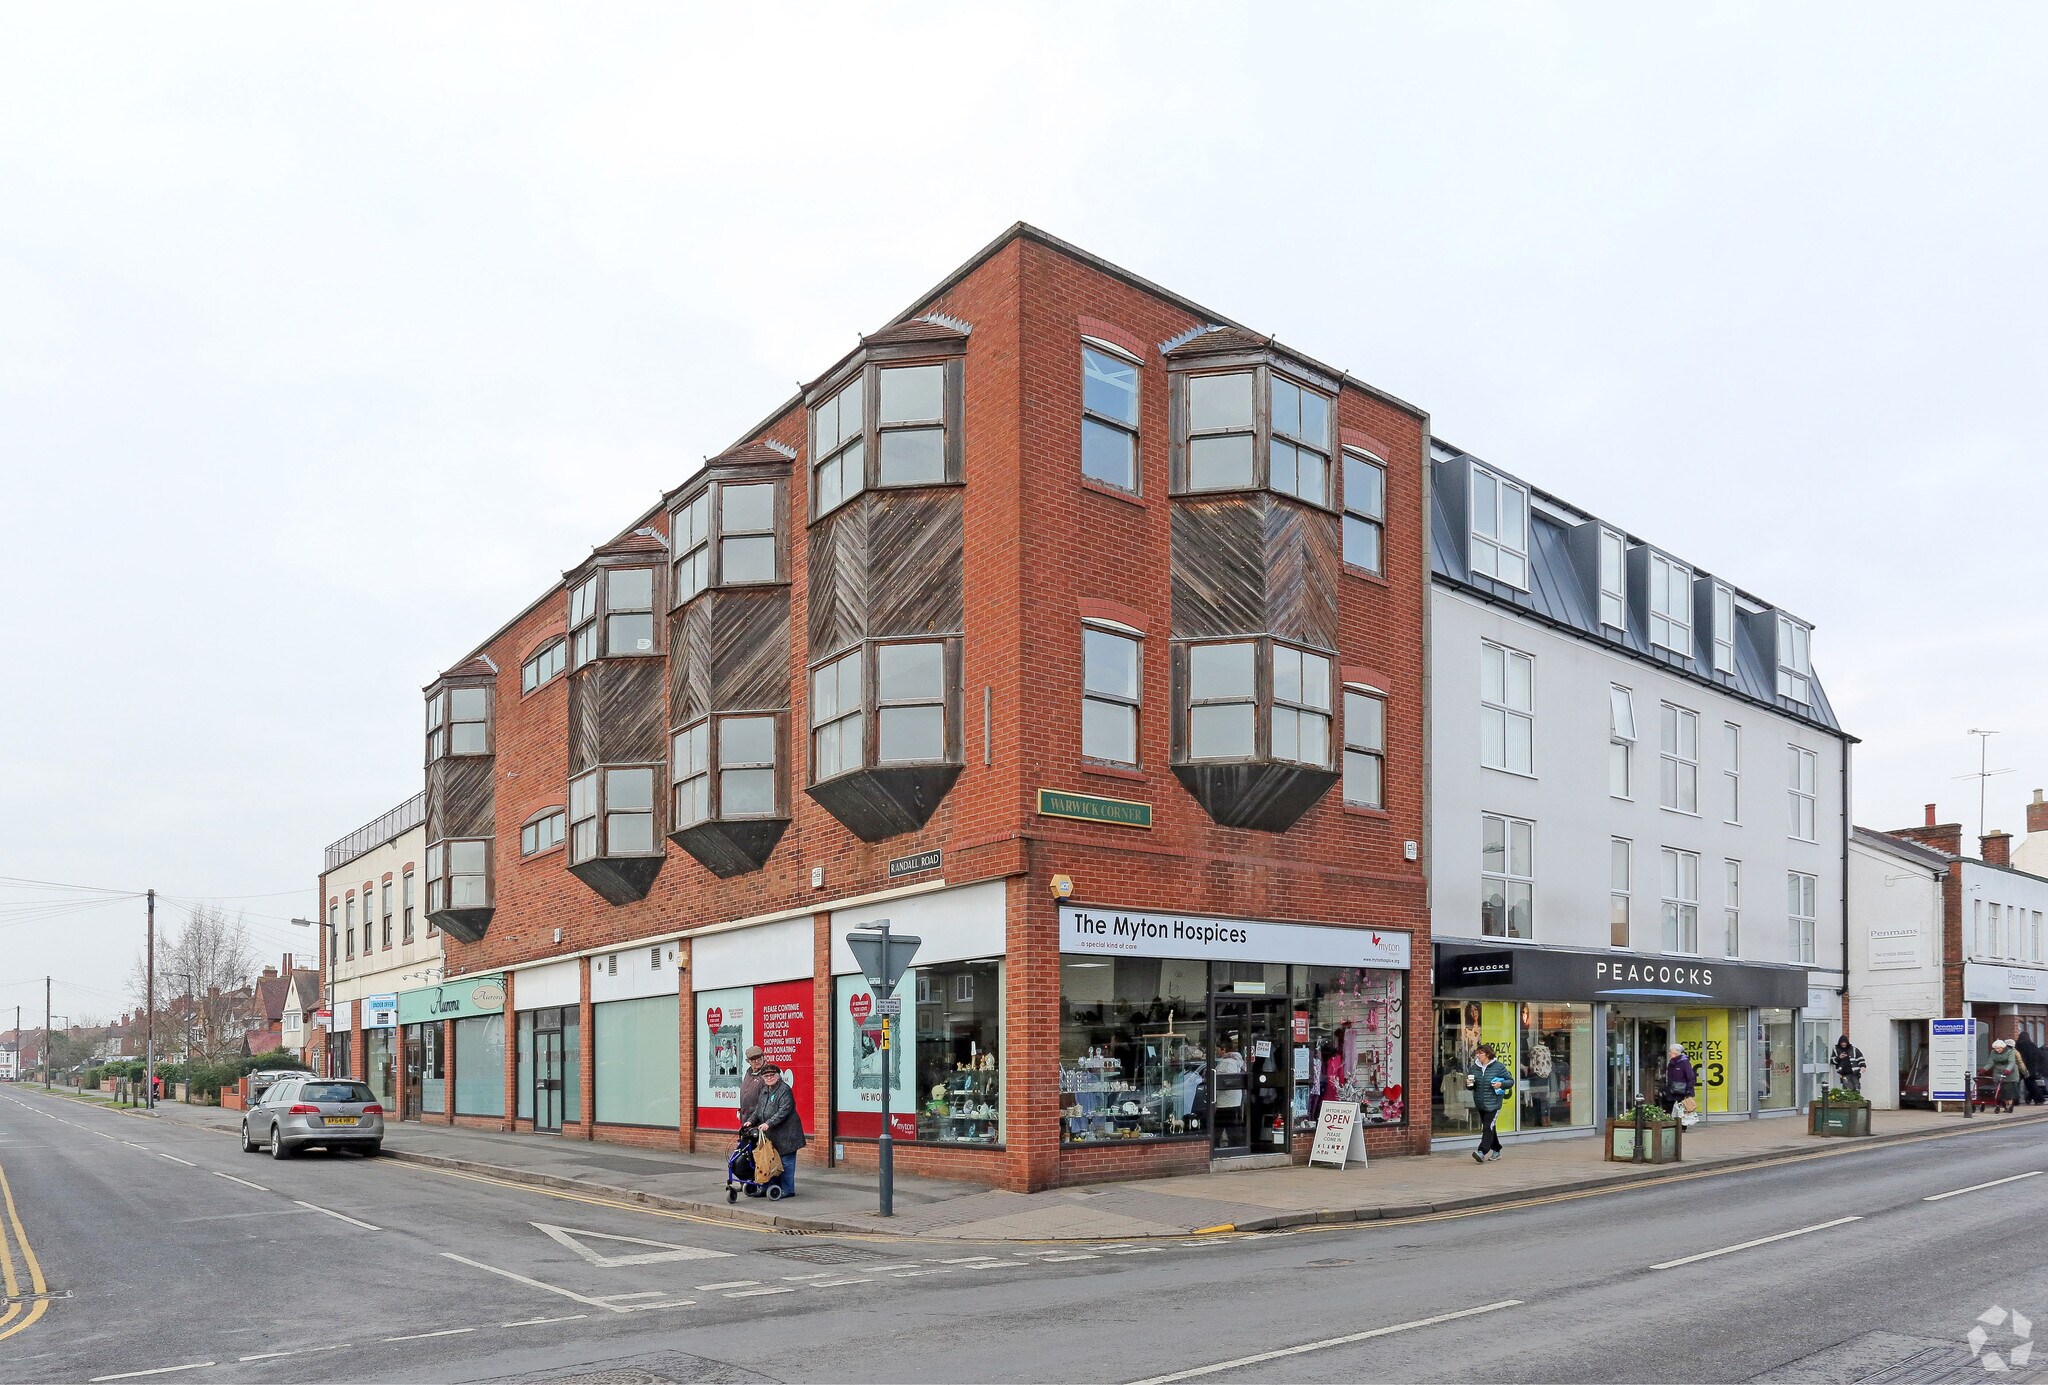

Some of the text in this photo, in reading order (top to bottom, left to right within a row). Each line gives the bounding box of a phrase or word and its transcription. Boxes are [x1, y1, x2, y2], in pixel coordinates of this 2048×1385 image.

[1050, 798, 1141, 820] WARWICK CORNER
[890, 854, 939, 873] RANDALL ROAD
[1075, 914, 1247, 945] The Myton Hospices
[1870, 929, 1918, 937] Penmans
[1086, 941, 1106, 949] special
[1378, 943, 1400, 953] myton
[1462, 964, 1510, 972] PEACOCKS
[1597, 962, 1713, 986] PEACOCKS
[2007, 970, 2037, 986] Penmans
[430, 987, 460, 1014] Aurora
[473, 991, 503, 1000] Aurora
[763, 1003, 800, 1013] PLEASE CONTINUE
[769, 1013, 787, 1021] SUPPORT
[763, 1038, 784, 1046] SHOPPING
[785, 1037, 796, 1045] WITH
[860, 1093, 869, 1101] WE
[1324, 1113, 1351, 1125] OPEN
[896, 1124, 915, 1132] myton
